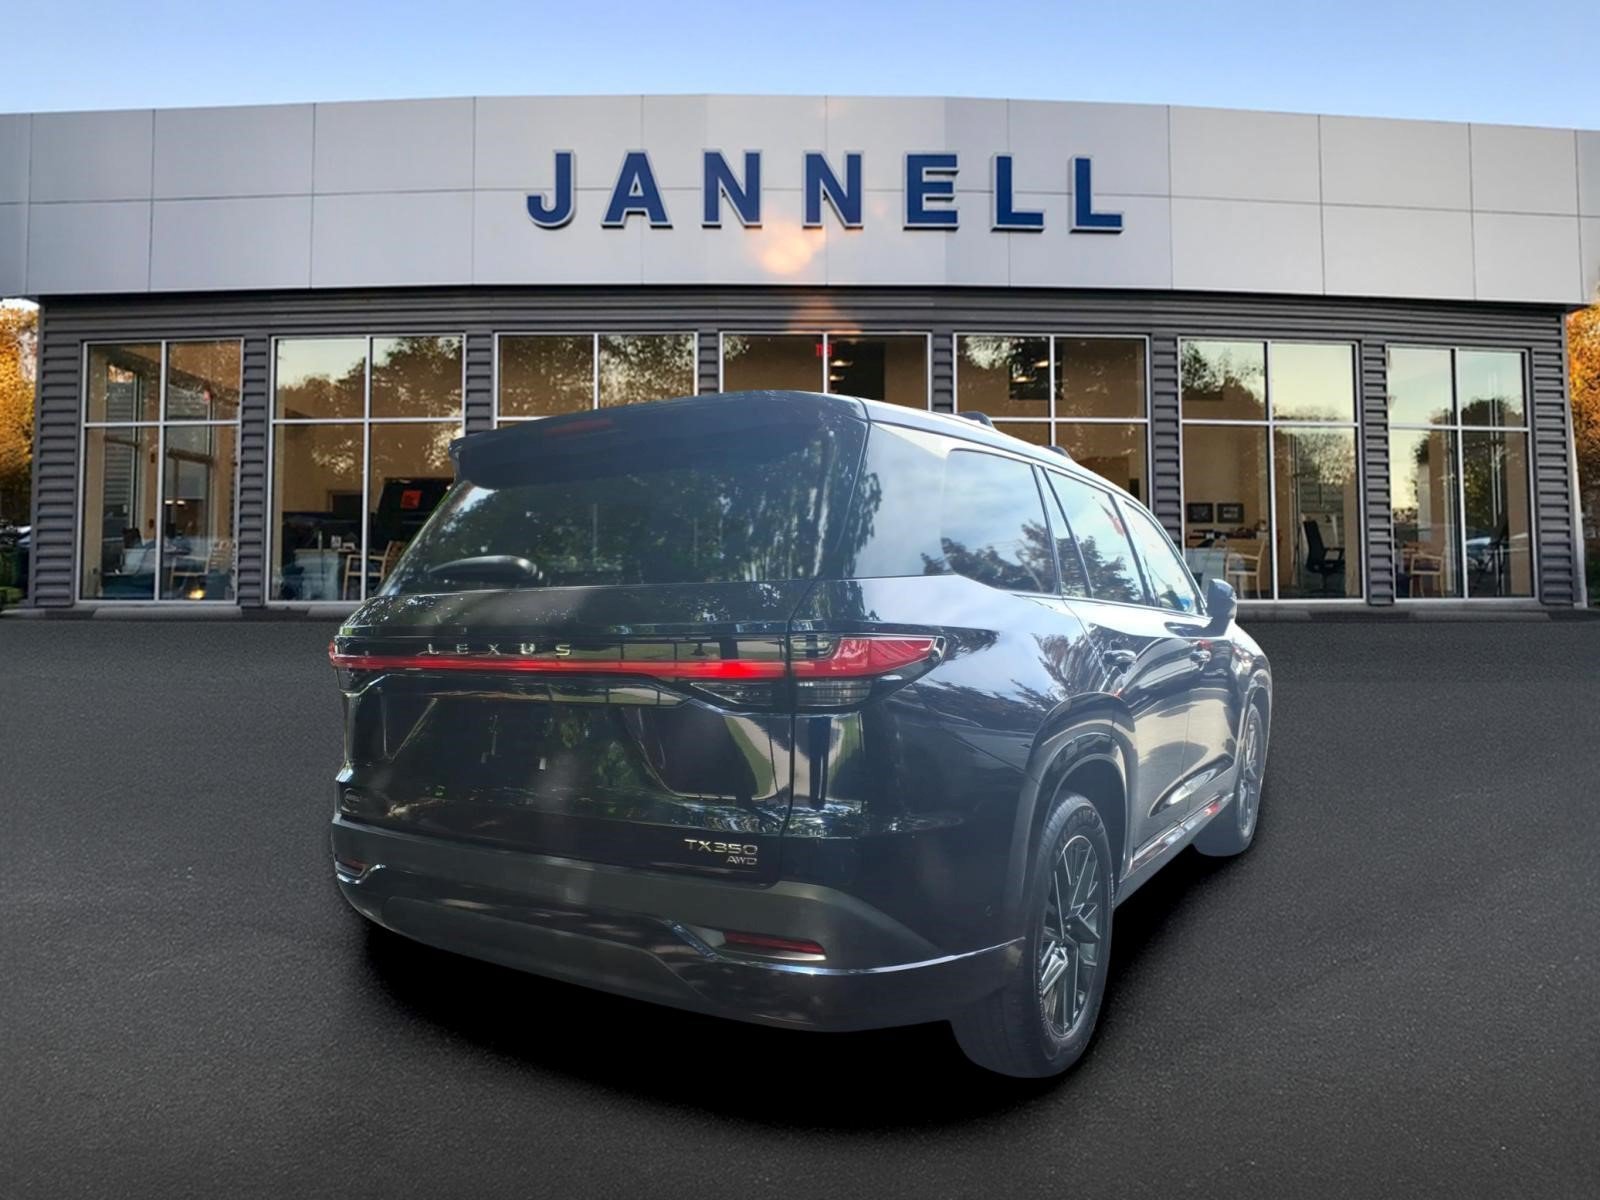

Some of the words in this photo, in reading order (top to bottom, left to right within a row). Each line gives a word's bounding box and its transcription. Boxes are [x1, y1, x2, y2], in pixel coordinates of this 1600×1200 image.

[526, 149, 1124, 233] JANNELL
[427, 642, 572, 656] LEXUS
[726, 855, 759, 866] AWD
